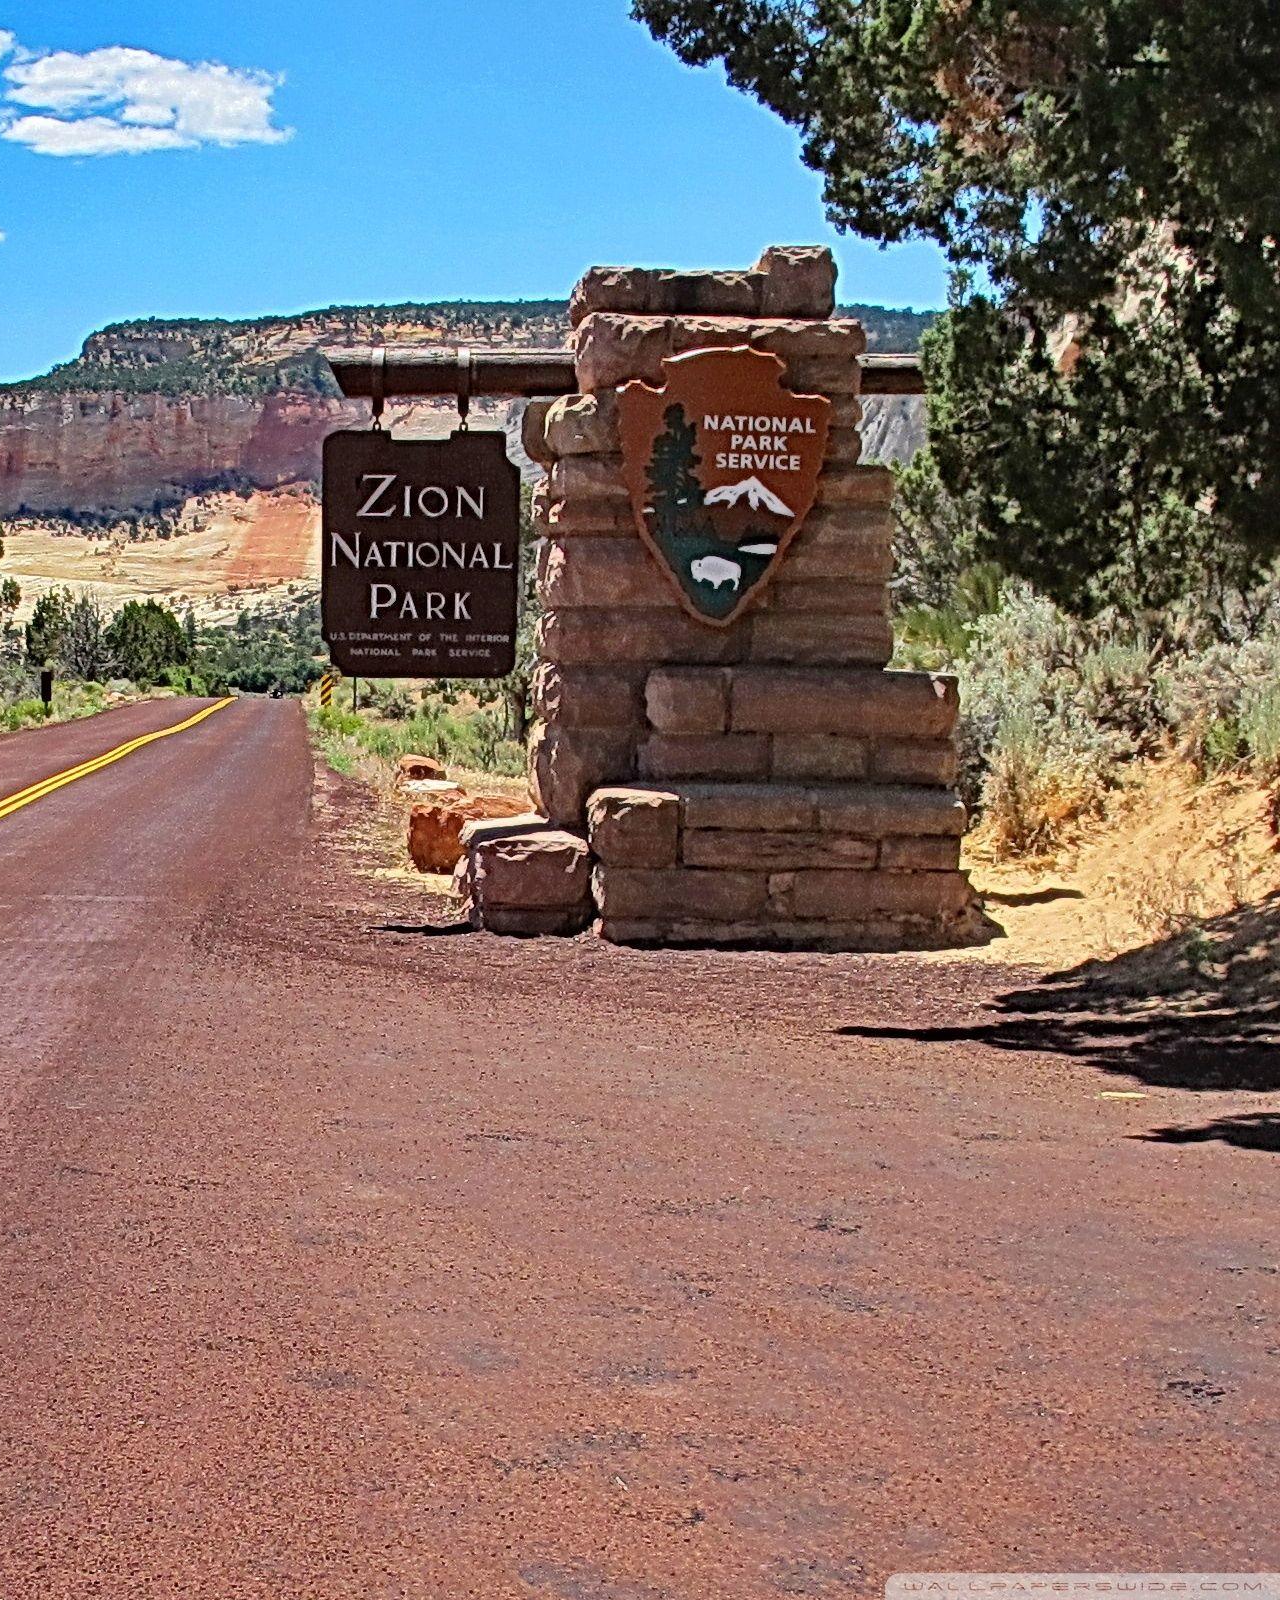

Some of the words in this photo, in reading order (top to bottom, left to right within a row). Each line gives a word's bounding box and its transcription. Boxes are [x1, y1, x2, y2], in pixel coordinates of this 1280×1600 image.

[703, 414, 817, 434] NATIONAL
[730, 434, 788, 452] PARK
[715, 452, 801, 471] SERVICE
[356, 474, 485, 520] ZION
[330, 531, 513, 569] NATIONAL
[370, 583, 472, 620] PARK
[348, 632, 413, 642] DEPARTMENT
[419, 633, 432, 642] OF
[440, 633, 458, 642] THE
[465, 633, 510, 643] INTERIOR
[350, 648, 401, 656] NATIONAL
[412, 648, 438, 657] PARK
[448, 648, 491, 657] SERVICE
